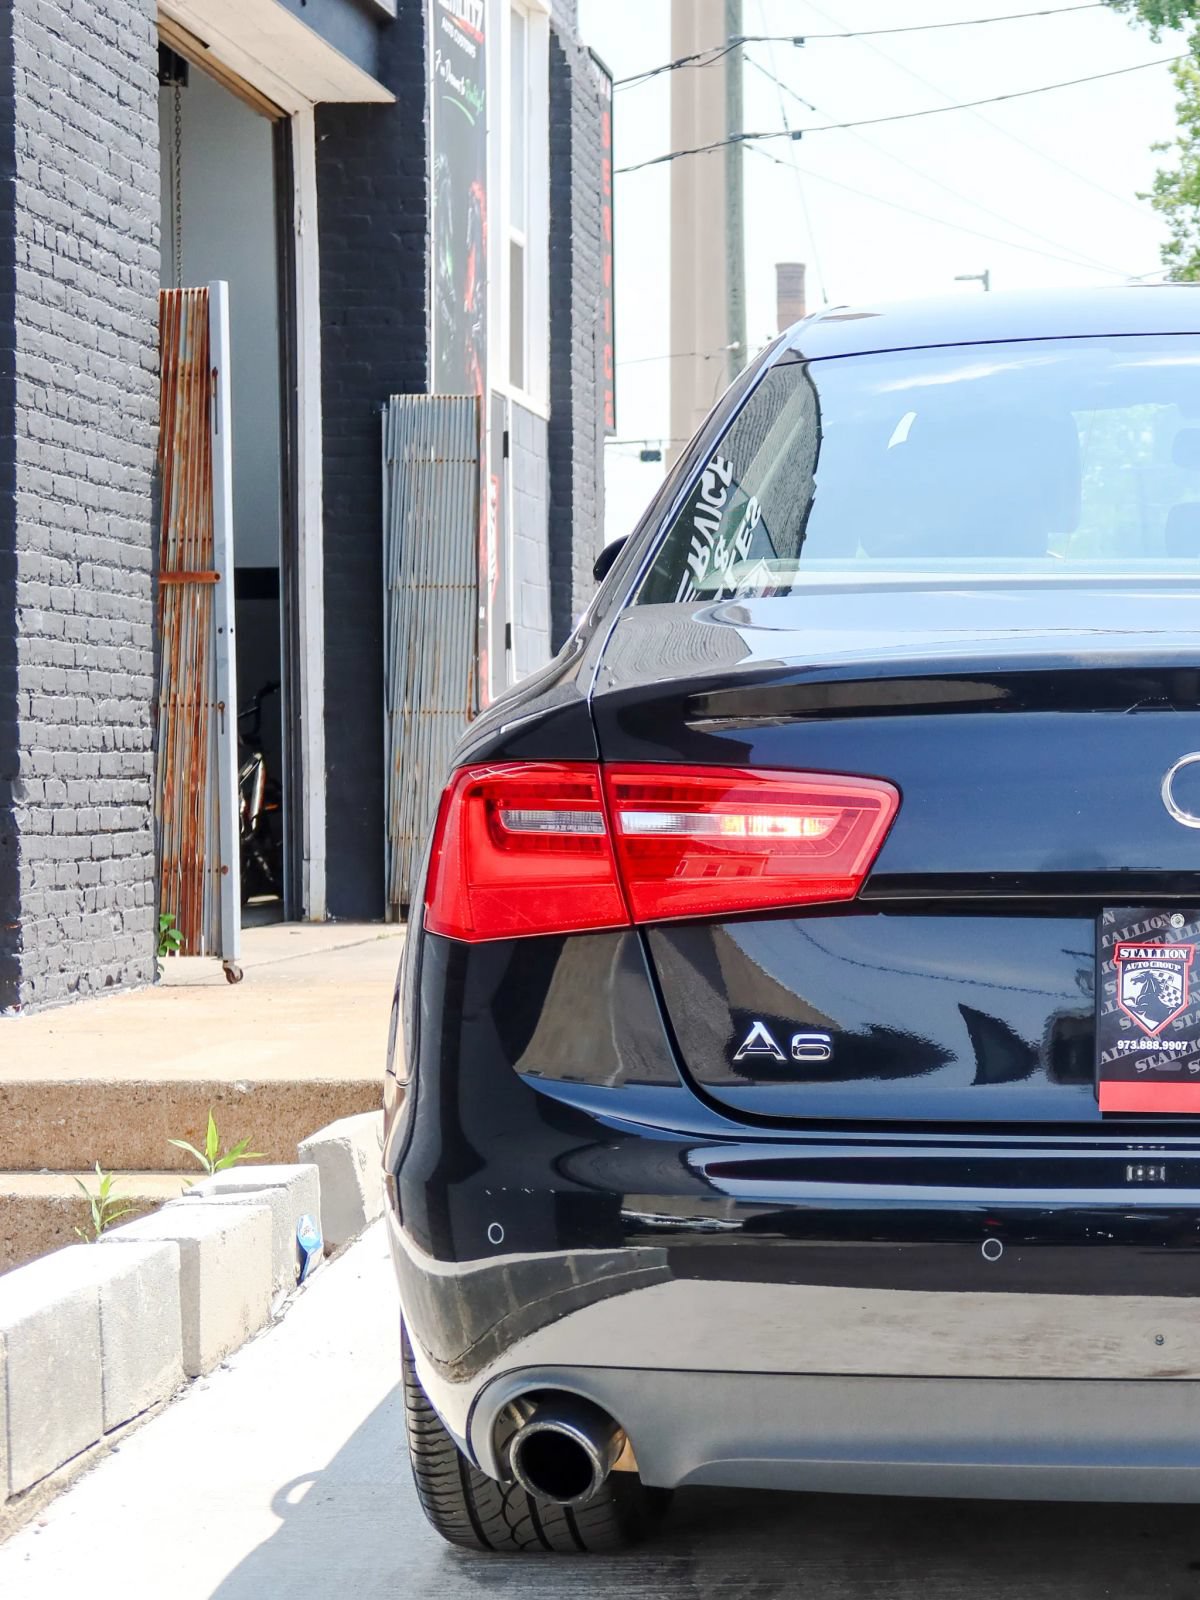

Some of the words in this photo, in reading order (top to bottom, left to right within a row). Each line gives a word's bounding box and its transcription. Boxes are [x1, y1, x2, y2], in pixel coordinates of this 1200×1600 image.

[1120, 948, 1187, 959] STALLION
[1125, 961, 1149, 971] AUTO
[1150, 961, 1181, 972] GROUP
[733, 1022, 831, 1060] A6
[1117, 1040, 1188, 1051] 973.888.9907
